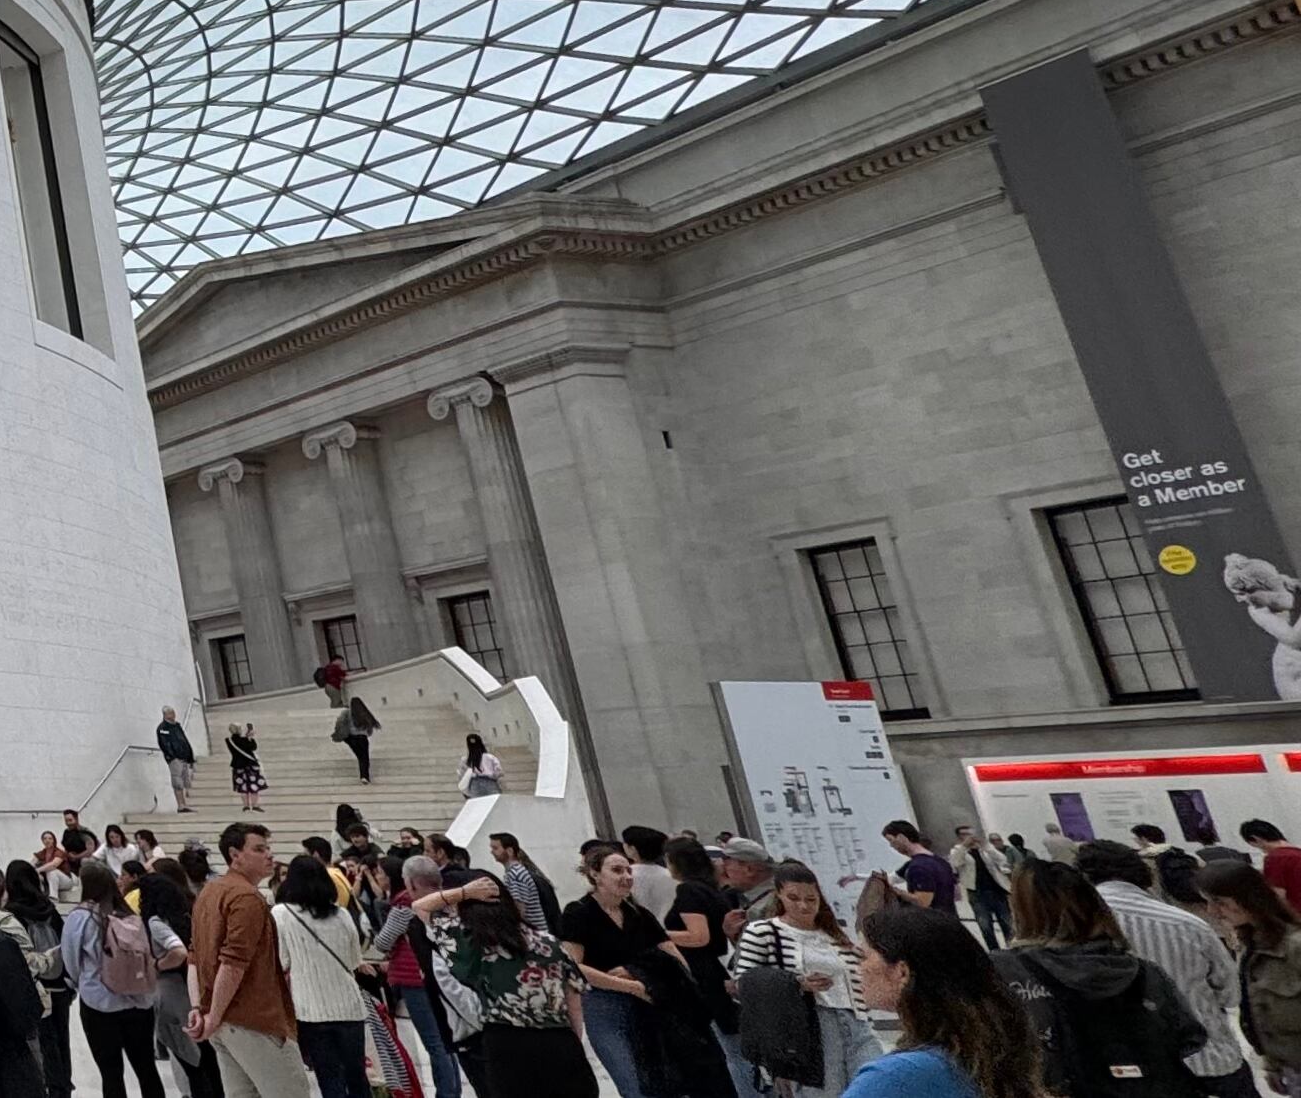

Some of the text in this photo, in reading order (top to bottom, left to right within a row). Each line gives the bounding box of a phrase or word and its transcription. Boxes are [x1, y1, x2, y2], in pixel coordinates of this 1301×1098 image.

[1122, 449, 1164, 469] Get
[1129, 460, 1229, 488] closer as
[1138, 477, 1246, 507] a Member
